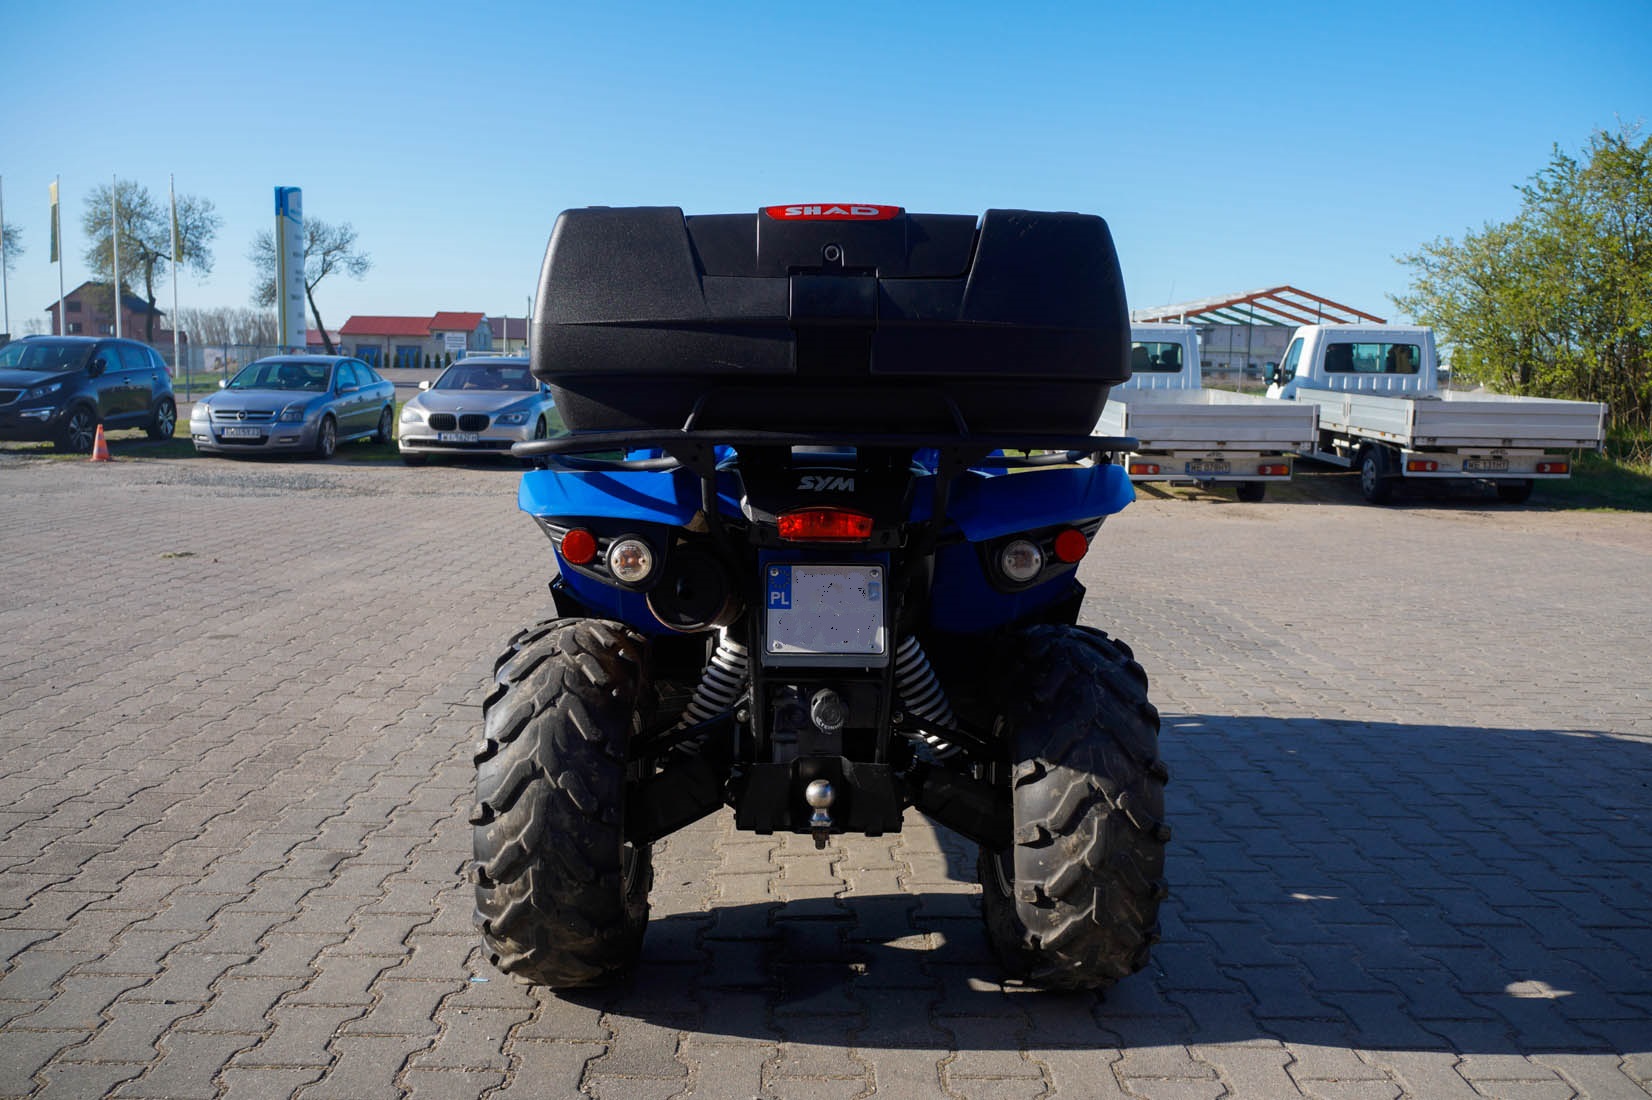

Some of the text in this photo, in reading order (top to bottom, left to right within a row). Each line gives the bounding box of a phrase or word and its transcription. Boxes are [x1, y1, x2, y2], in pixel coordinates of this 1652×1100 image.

[785, 206, 880, 216] SHAD
[797, 475, 855, 492] SYM
[770, 592, 790, 605] PL
